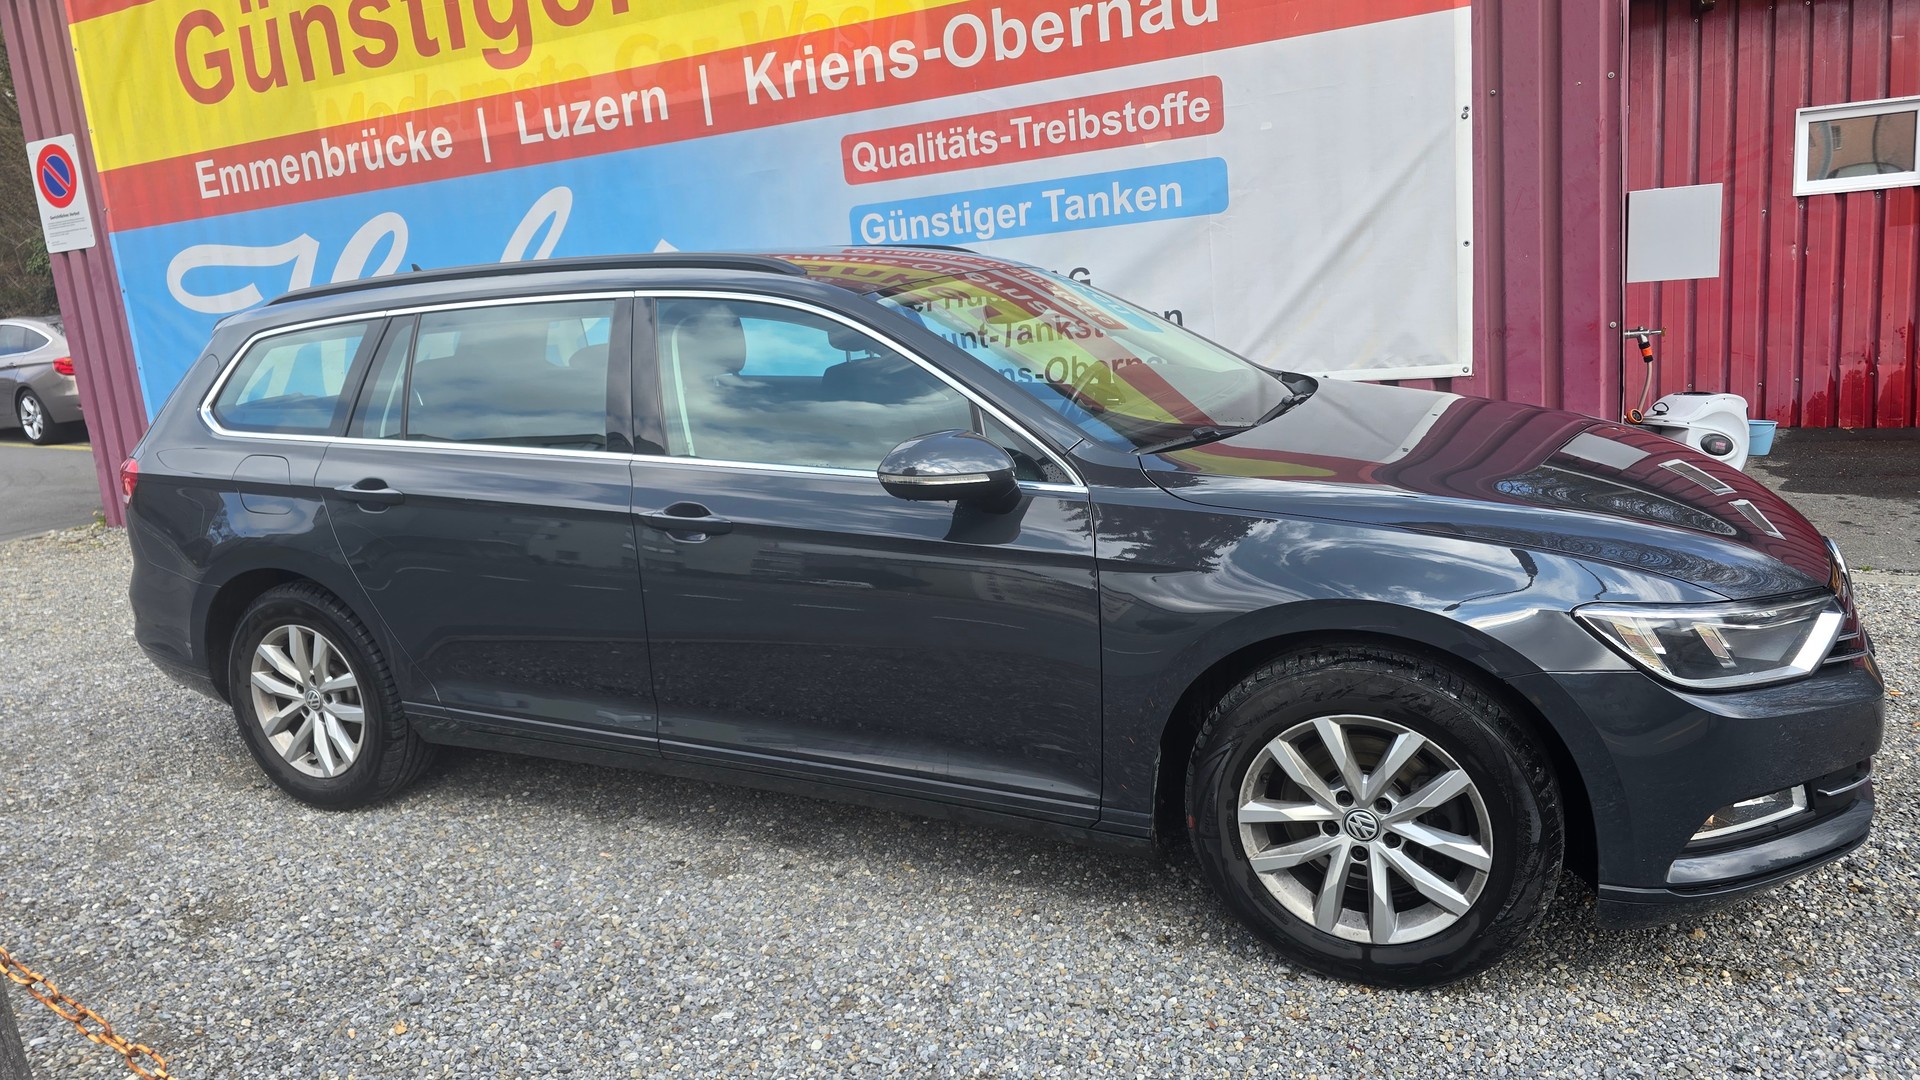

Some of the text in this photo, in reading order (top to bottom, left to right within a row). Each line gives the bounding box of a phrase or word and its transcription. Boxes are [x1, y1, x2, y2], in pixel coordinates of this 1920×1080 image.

[174, 0, 630, 105] Günstig
[195, 0, 1219, 199] Emmenbrücke Luzern Kriens-Obernau
[852, 91, 1211, 173] Qualitäts-Treibstoffe
[860, 181, 1183, 245] Günstiger Tanken
